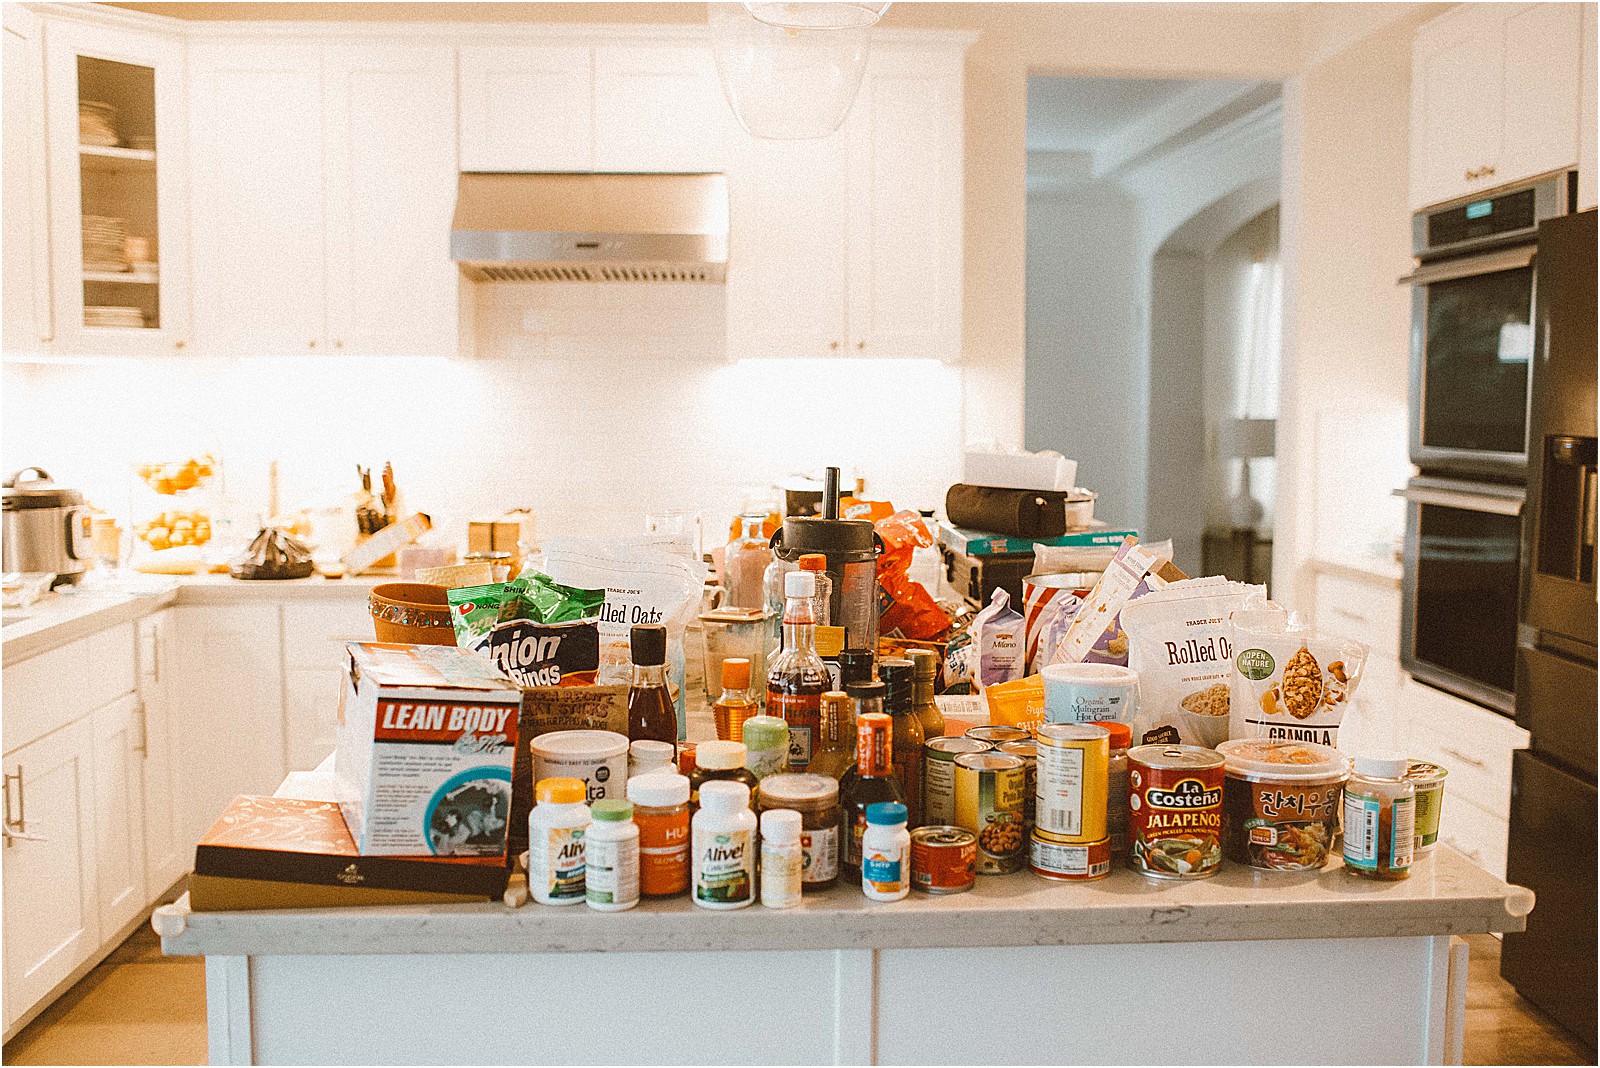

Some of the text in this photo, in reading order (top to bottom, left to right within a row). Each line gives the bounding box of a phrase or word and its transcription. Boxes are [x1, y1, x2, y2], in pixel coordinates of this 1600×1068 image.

[631, 605, 663, 625] Oats
[1165, 637, 1217, 665] Rolled
[1246, 652, 1266, 660] OPEN
[1242, 657, 1270, 669] NATURE
[1070, 704, 1110, 714] Multigrain
[1076, 696, 1104, 707] Organic
[382, 704, 512, 733] LEAN BODY
[1076, 711, 1117, 722] Hot Cereal
[1269, 727, 1332, 747] GRANOLA
[1182, 782, 1200, 794] La
[1151, 791, 1219, 807] Costeña
[1146, 811, 1220, 829] JALAPEÑOS
[702, 843, 745, 862] Alive!
